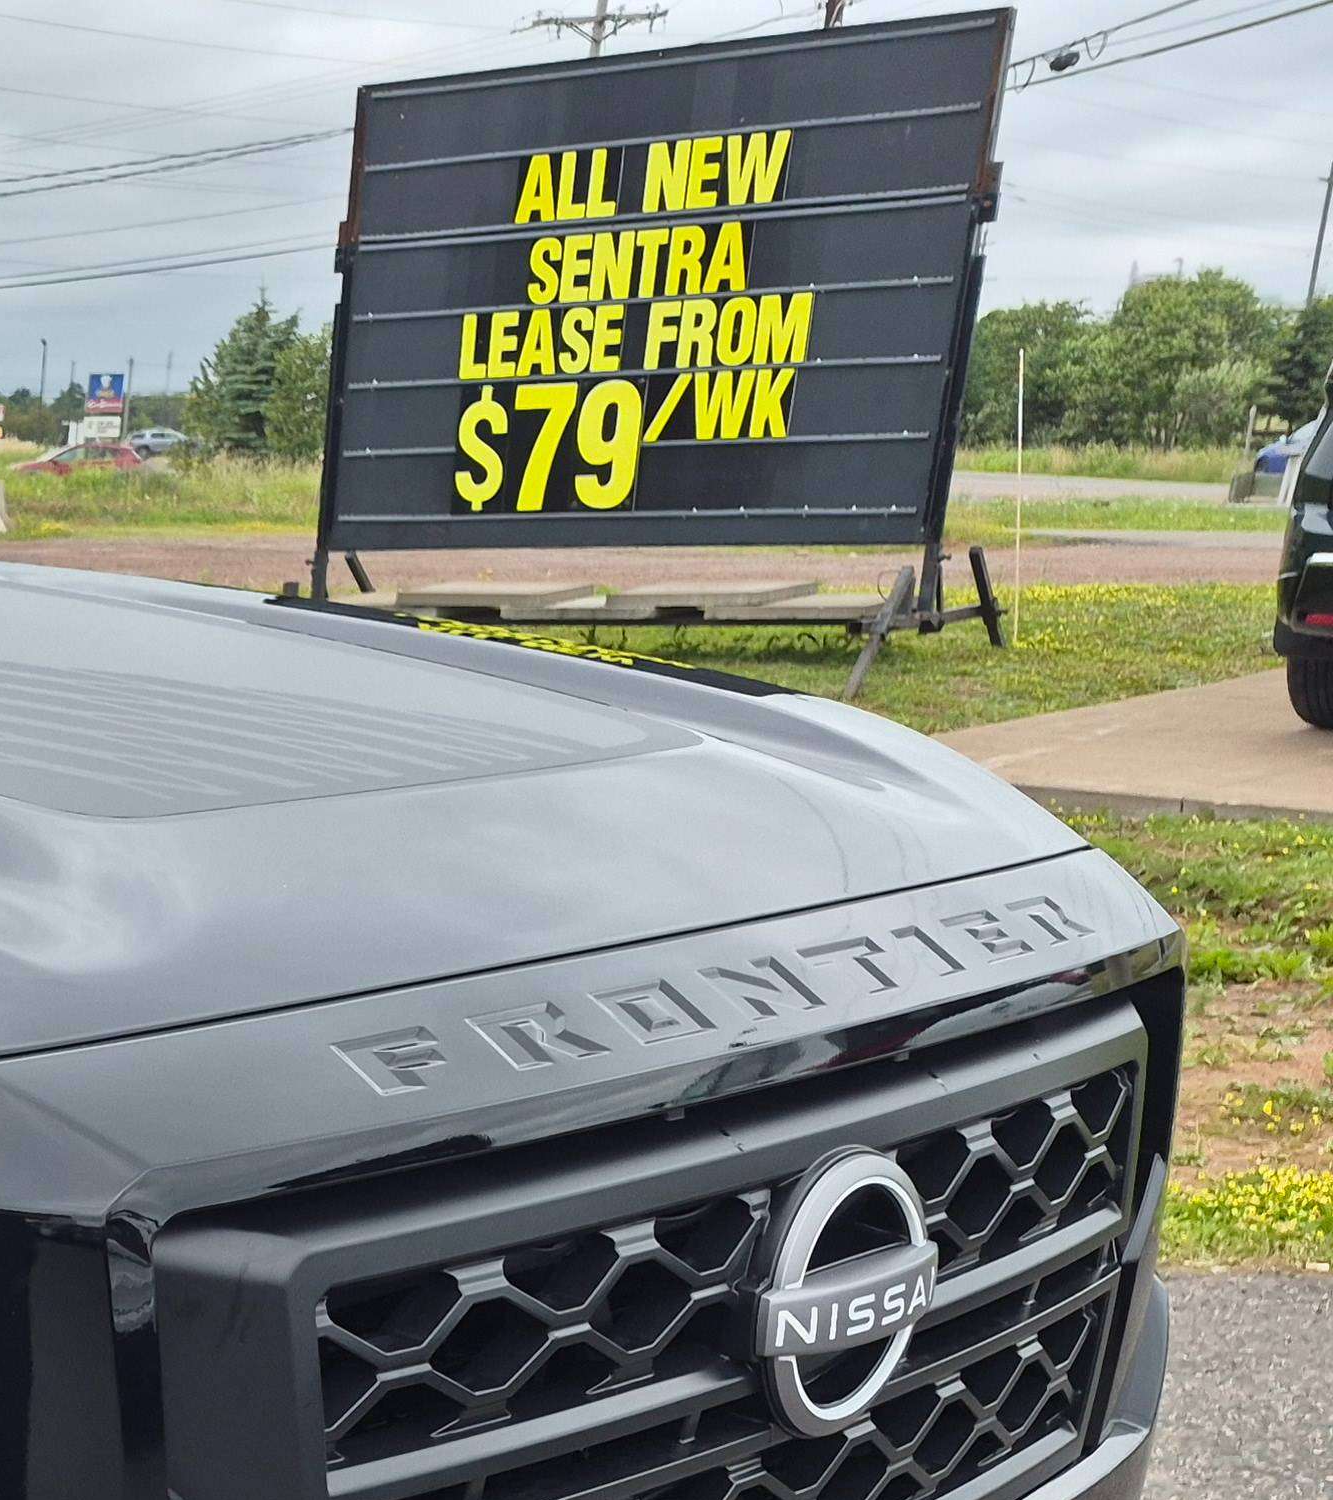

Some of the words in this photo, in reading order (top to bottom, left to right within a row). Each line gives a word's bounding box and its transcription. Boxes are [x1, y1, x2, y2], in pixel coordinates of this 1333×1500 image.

[514, 148, 617, 225] ALL
[643, 130, 792, 214] NEW
[527, 221, 746, 306] SENTRA
[458, 303, 625, 380] LEASE
[645, 291, 815, 370] FROM
[455, 367, 795, 512] $79/WK
[329, 895, 1097, 1096] FRONTIER
